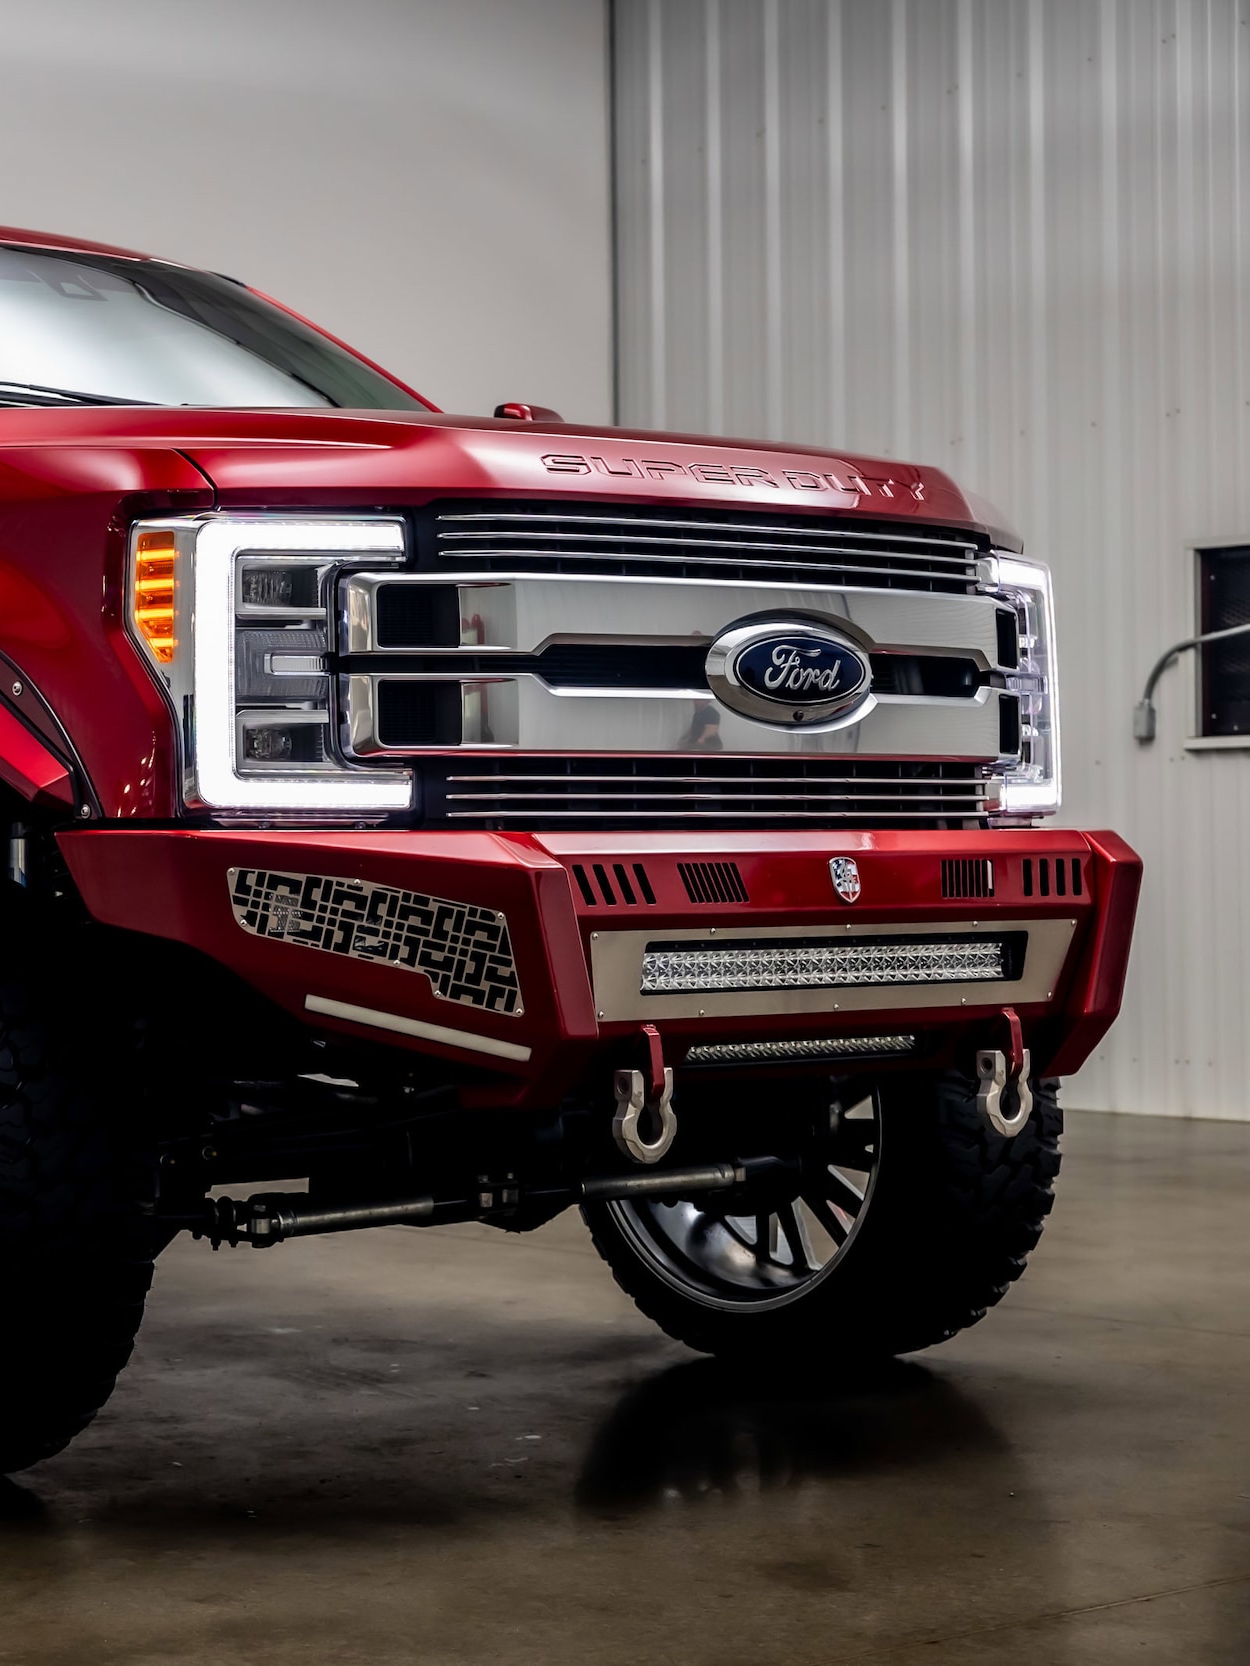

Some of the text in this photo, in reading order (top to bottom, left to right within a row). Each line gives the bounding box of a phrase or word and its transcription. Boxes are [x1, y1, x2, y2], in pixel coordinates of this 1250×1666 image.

[540, 453, 925, 501] SUPER DUTY
[764, 644, 842, 692] Ford
